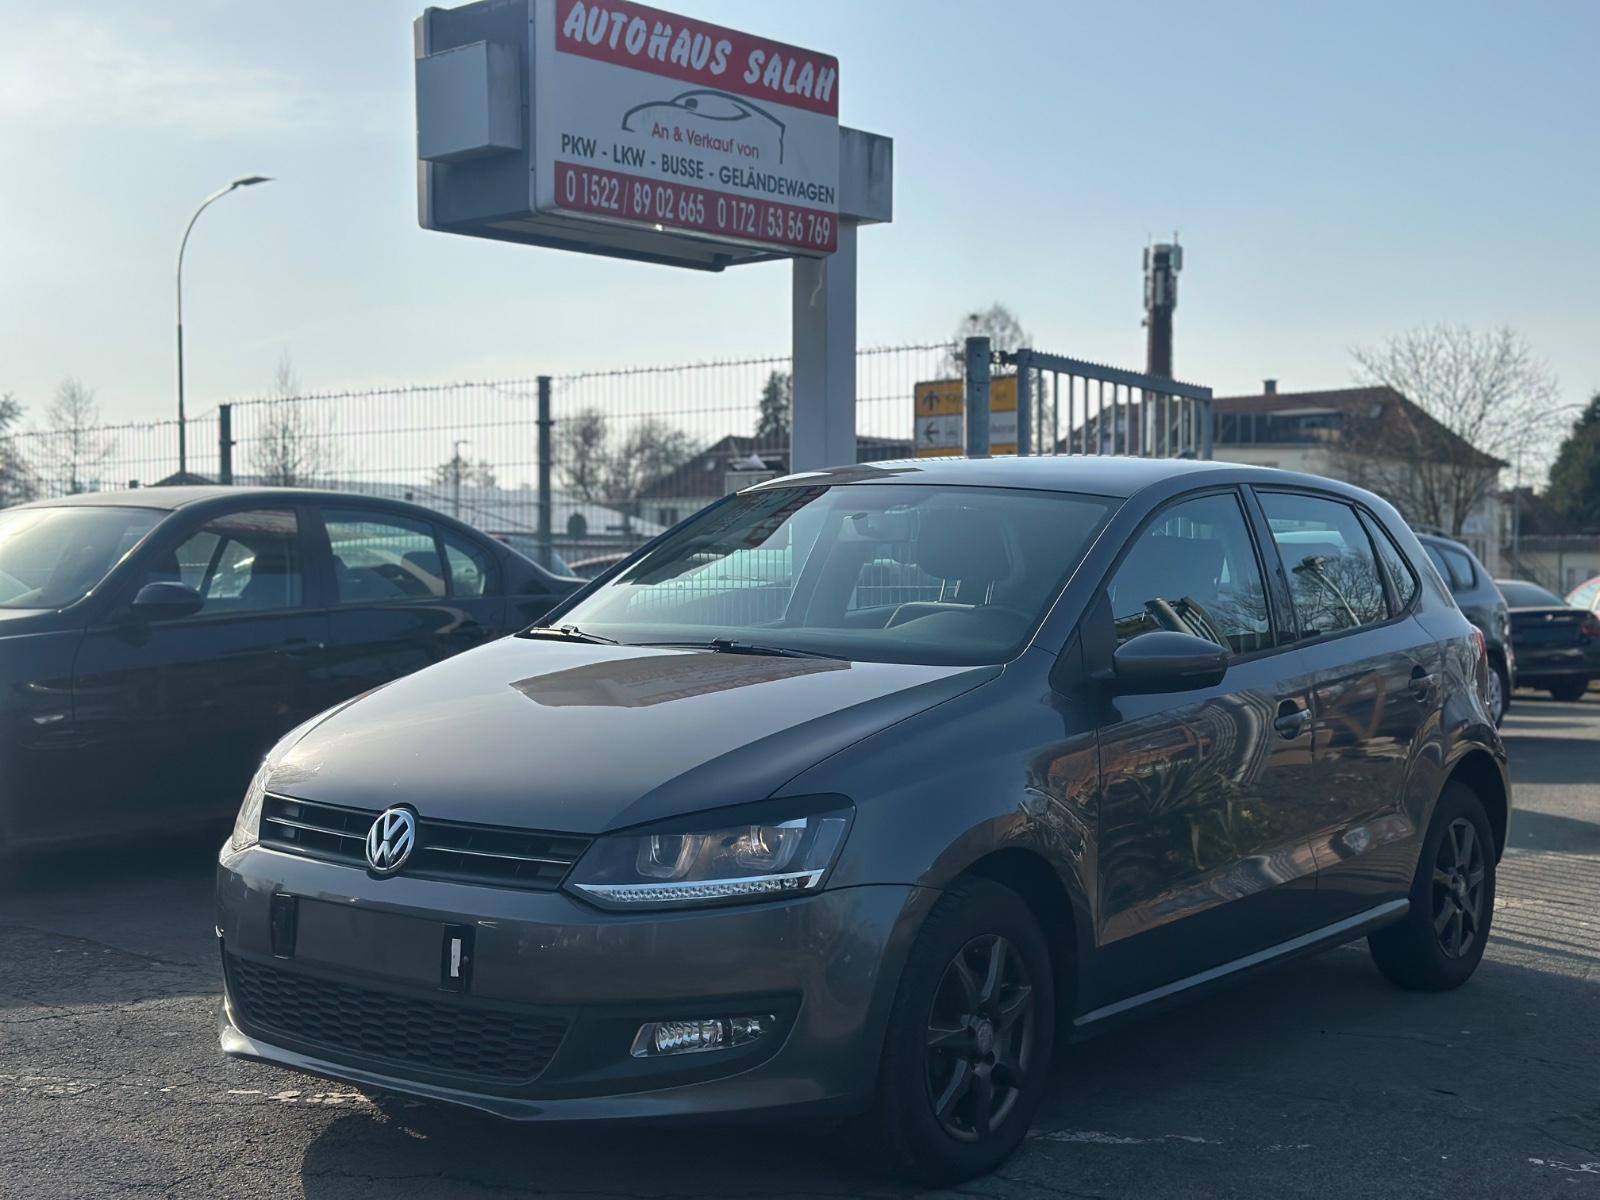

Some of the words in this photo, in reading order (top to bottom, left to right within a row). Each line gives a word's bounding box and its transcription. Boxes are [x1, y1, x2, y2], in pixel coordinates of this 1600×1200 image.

[563, 1, 732, 75] AUTOHAUS
[744, 50, 835, 102] SALAH
[562, 134, 597, 158] PKW
[613, 144, 645, 168] LKW
[661, 153, 704, 179] BUSSE
[719, 165, 835, 204] GELÄNDEWAGEN
[652, 122, 669, 140] An
[673, 126, 683, 142] &
[686, 129, 734, 153] Verkauf
[737, 143, 759, 159] von
[566, 170, 576, 203] 0
[582, 173, 619, 210] 1522
[633, 182, 652, 215] 89
[656, 186, 674, 219] 02
[678, 191, 705, 224] 665
[731, 200, 756, 233] 172
[767, 207, 784, 238] 53
[787, 211, 804, 241] 56
[808, 214, 831, 245] 769
